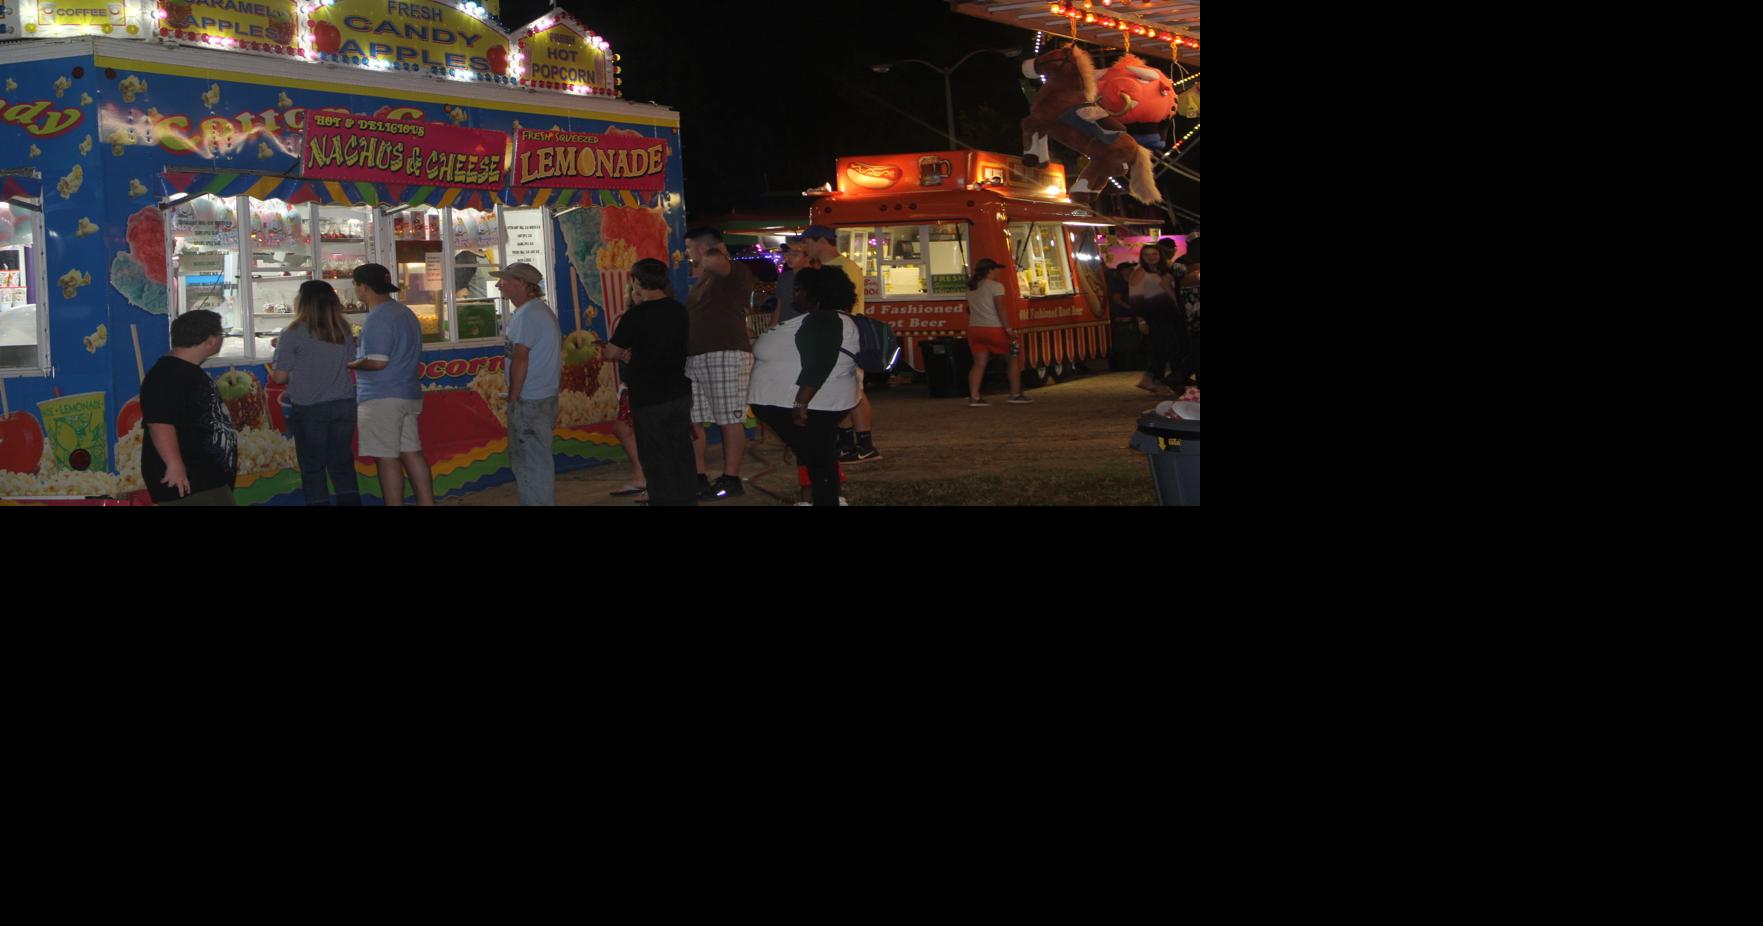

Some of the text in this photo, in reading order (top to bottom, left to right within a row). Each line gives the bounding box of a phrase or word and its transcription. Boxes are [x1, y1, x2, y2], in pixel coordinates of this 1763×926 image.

[56, 8, 108, 17] COFFEE
[387, 0, 443, 22] FRESH
[182, 15, 279, 39] APPLES
[343, 16, 481, 48] CANDY
[338, 39, 490, 71] APPLES
[547, 47, 578, 62] HOT
[531, 63, 596, 84] POPCORN
[314, 115, 342, 128] HOT
[357, 120, 426, 137] DELICIOUS
[521, 130, 600, 144] FRESH SQUEEZED
[308, 134, 501, 184] NACHOS & CHEESE
[519, 143, 664, 185] LEMONADE
[880, 303, 964, 315] Fashioned
[908, 318, 947, 328] Beer
